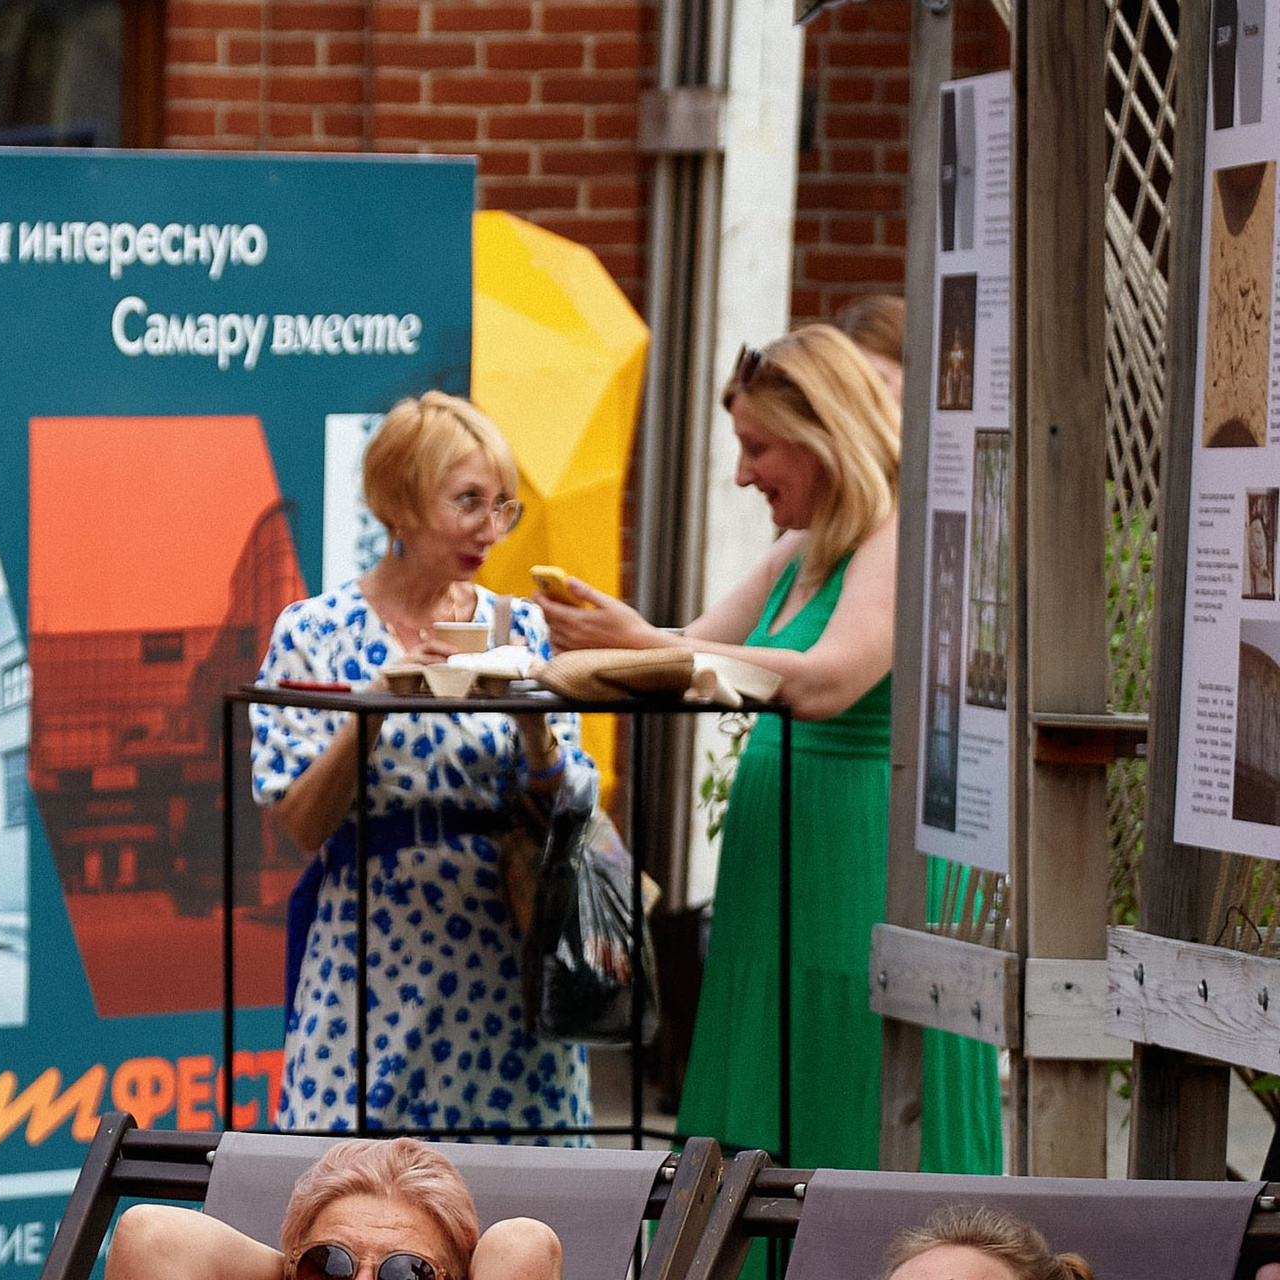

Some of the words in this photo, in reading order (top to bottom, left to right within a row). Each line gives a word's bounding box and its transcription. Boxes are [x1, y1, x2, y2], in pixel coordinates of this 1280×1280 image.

[19, 220, 269, 281] интересную
[111, 295, 269, 370] Самару
[271, 313, 422, 356] вместе
